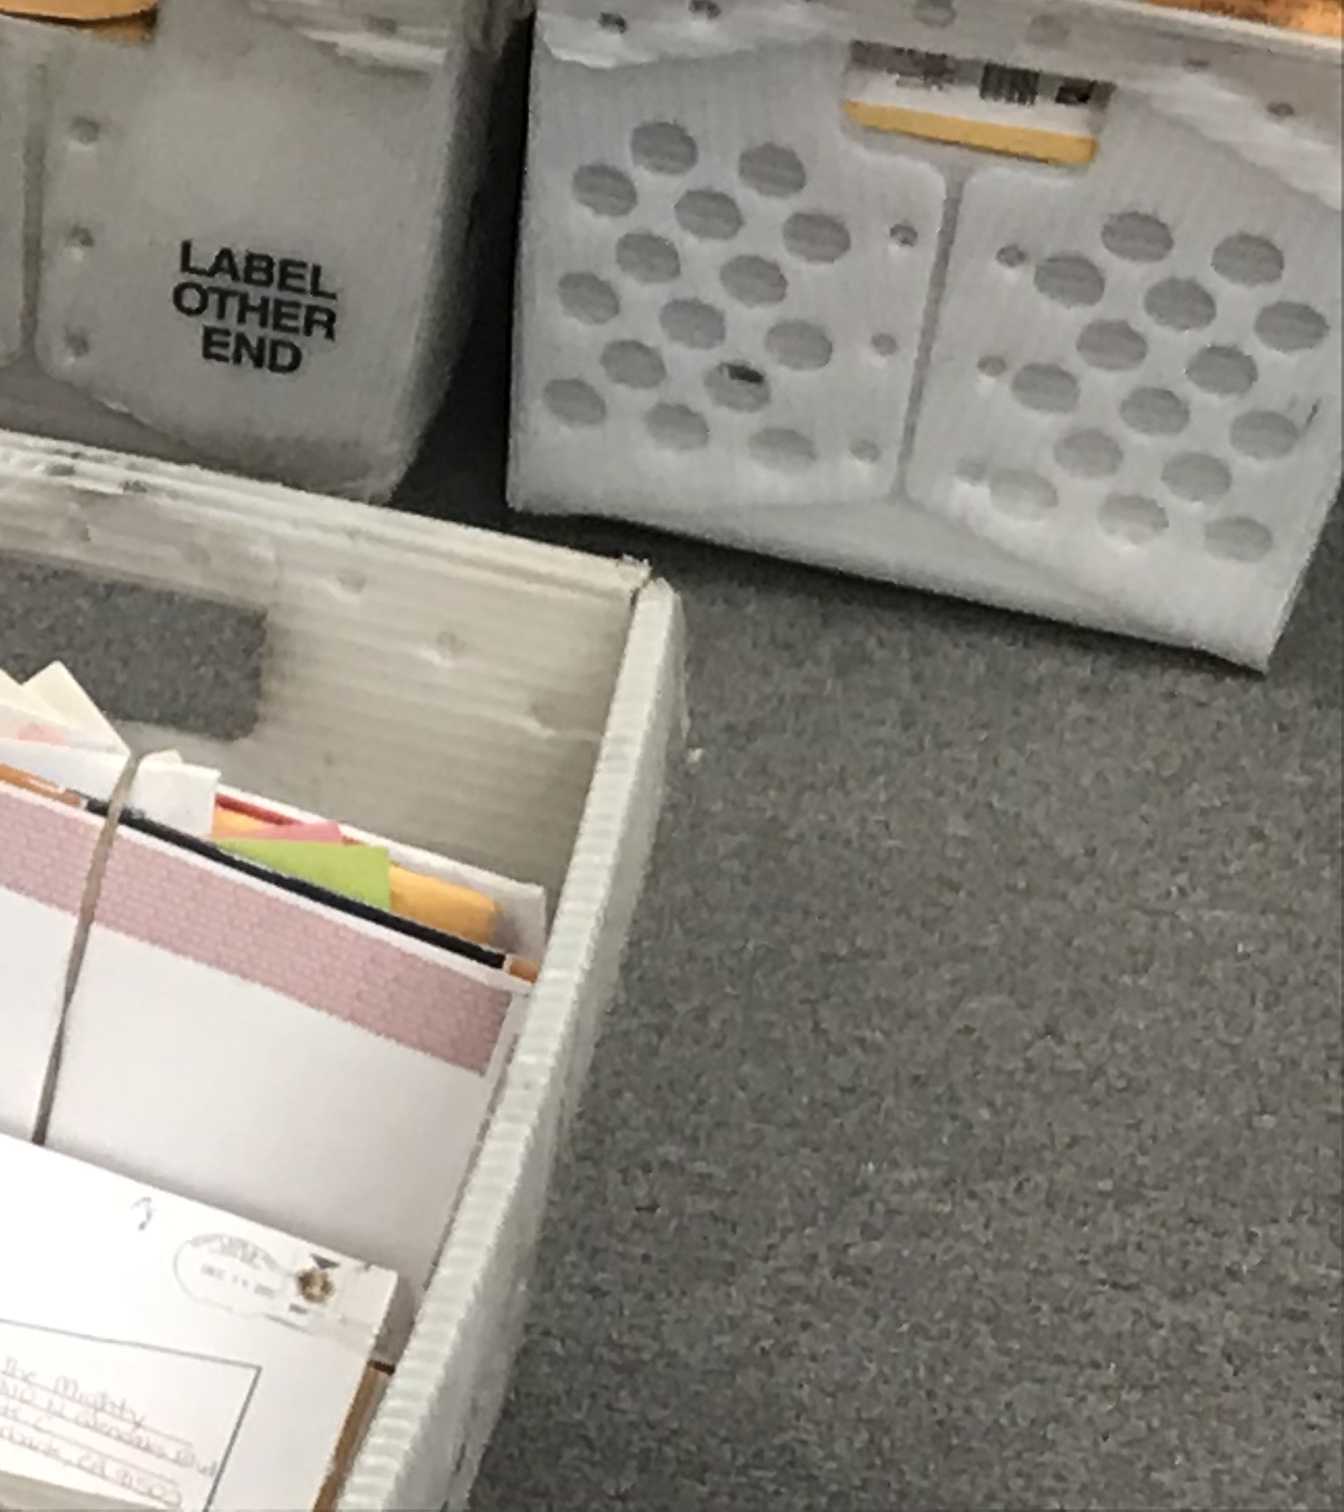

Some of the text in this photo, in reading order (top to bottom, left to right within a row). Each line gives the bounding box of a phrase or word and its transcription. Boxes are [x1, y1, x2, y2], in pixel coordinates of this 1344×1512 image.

[178, 239, 338, 301] LABEL
[172, 280, 337, 342] OTHER
[201, 323, 303, 375] END
